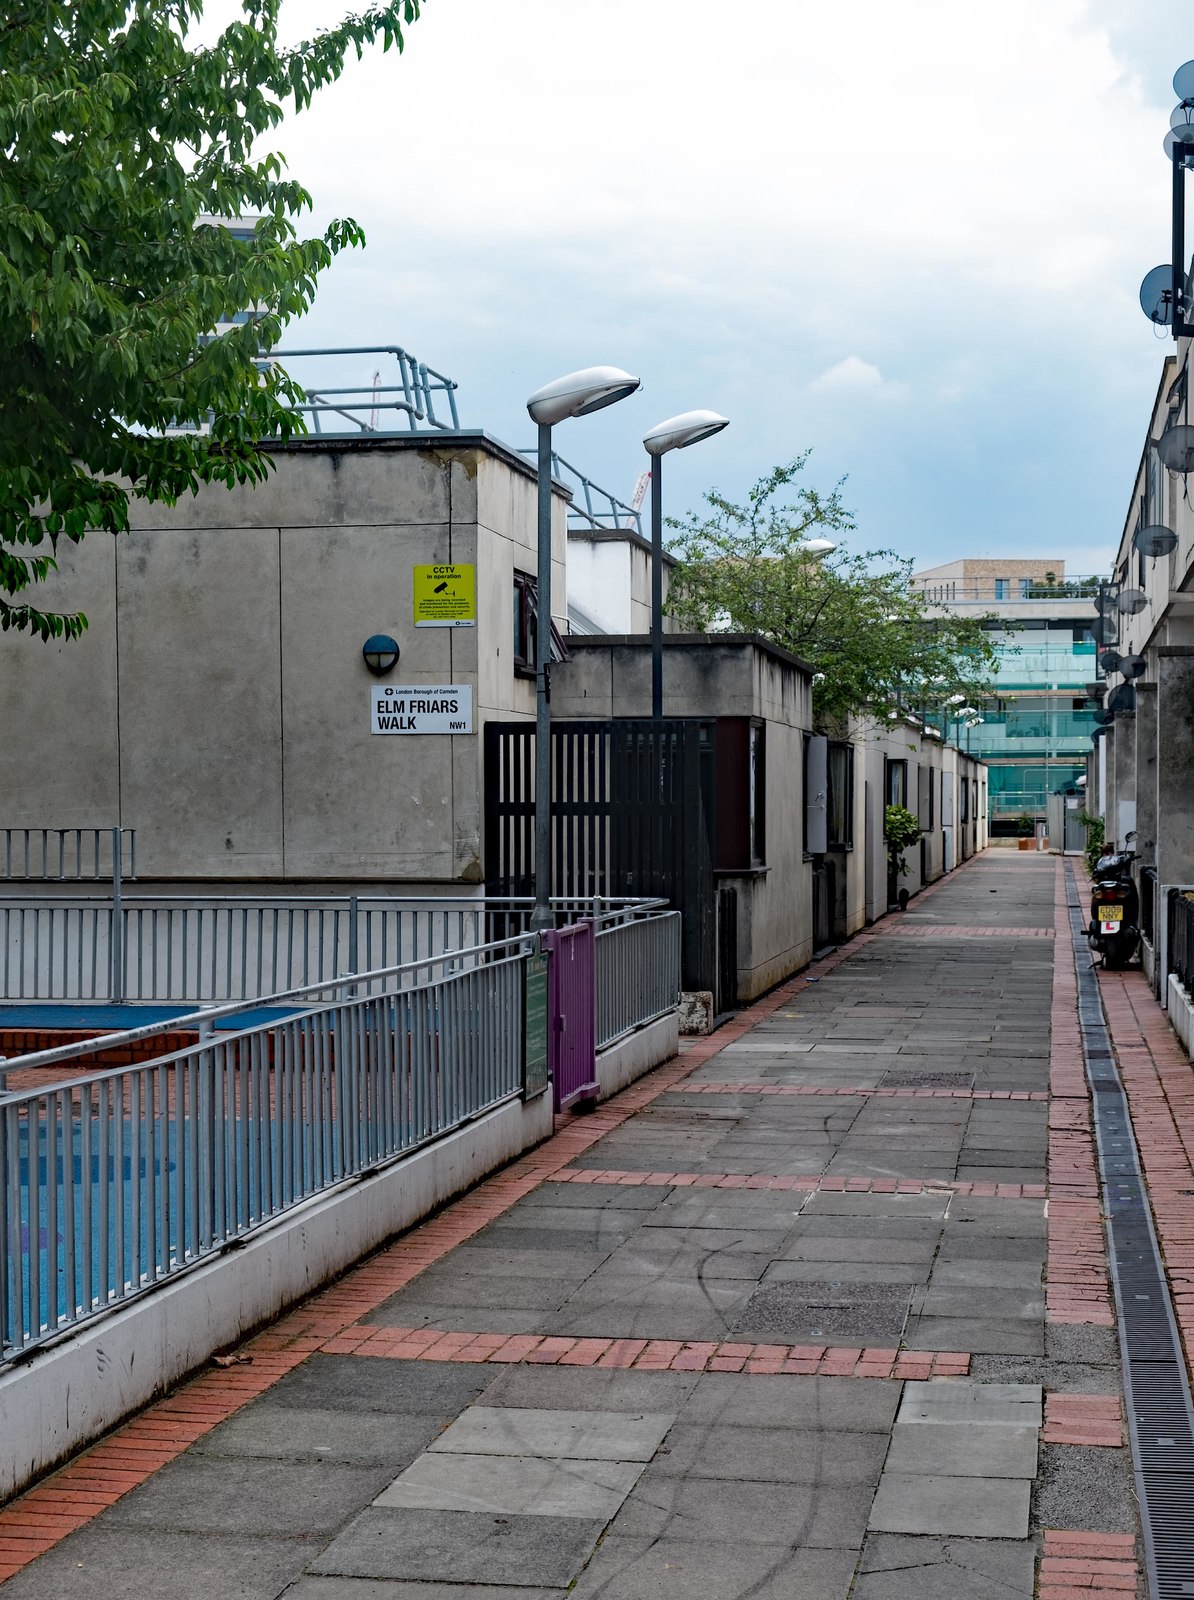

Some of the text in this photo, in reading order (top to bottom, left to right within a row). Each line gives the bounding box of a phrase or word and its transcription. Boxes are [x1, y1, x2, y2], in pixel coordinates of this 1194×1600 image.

[377, 699, 459, 714] ELM FRIARS
[377, 716, 466, 730] WALK NW1
[1105, 922, 1115, 930] L
